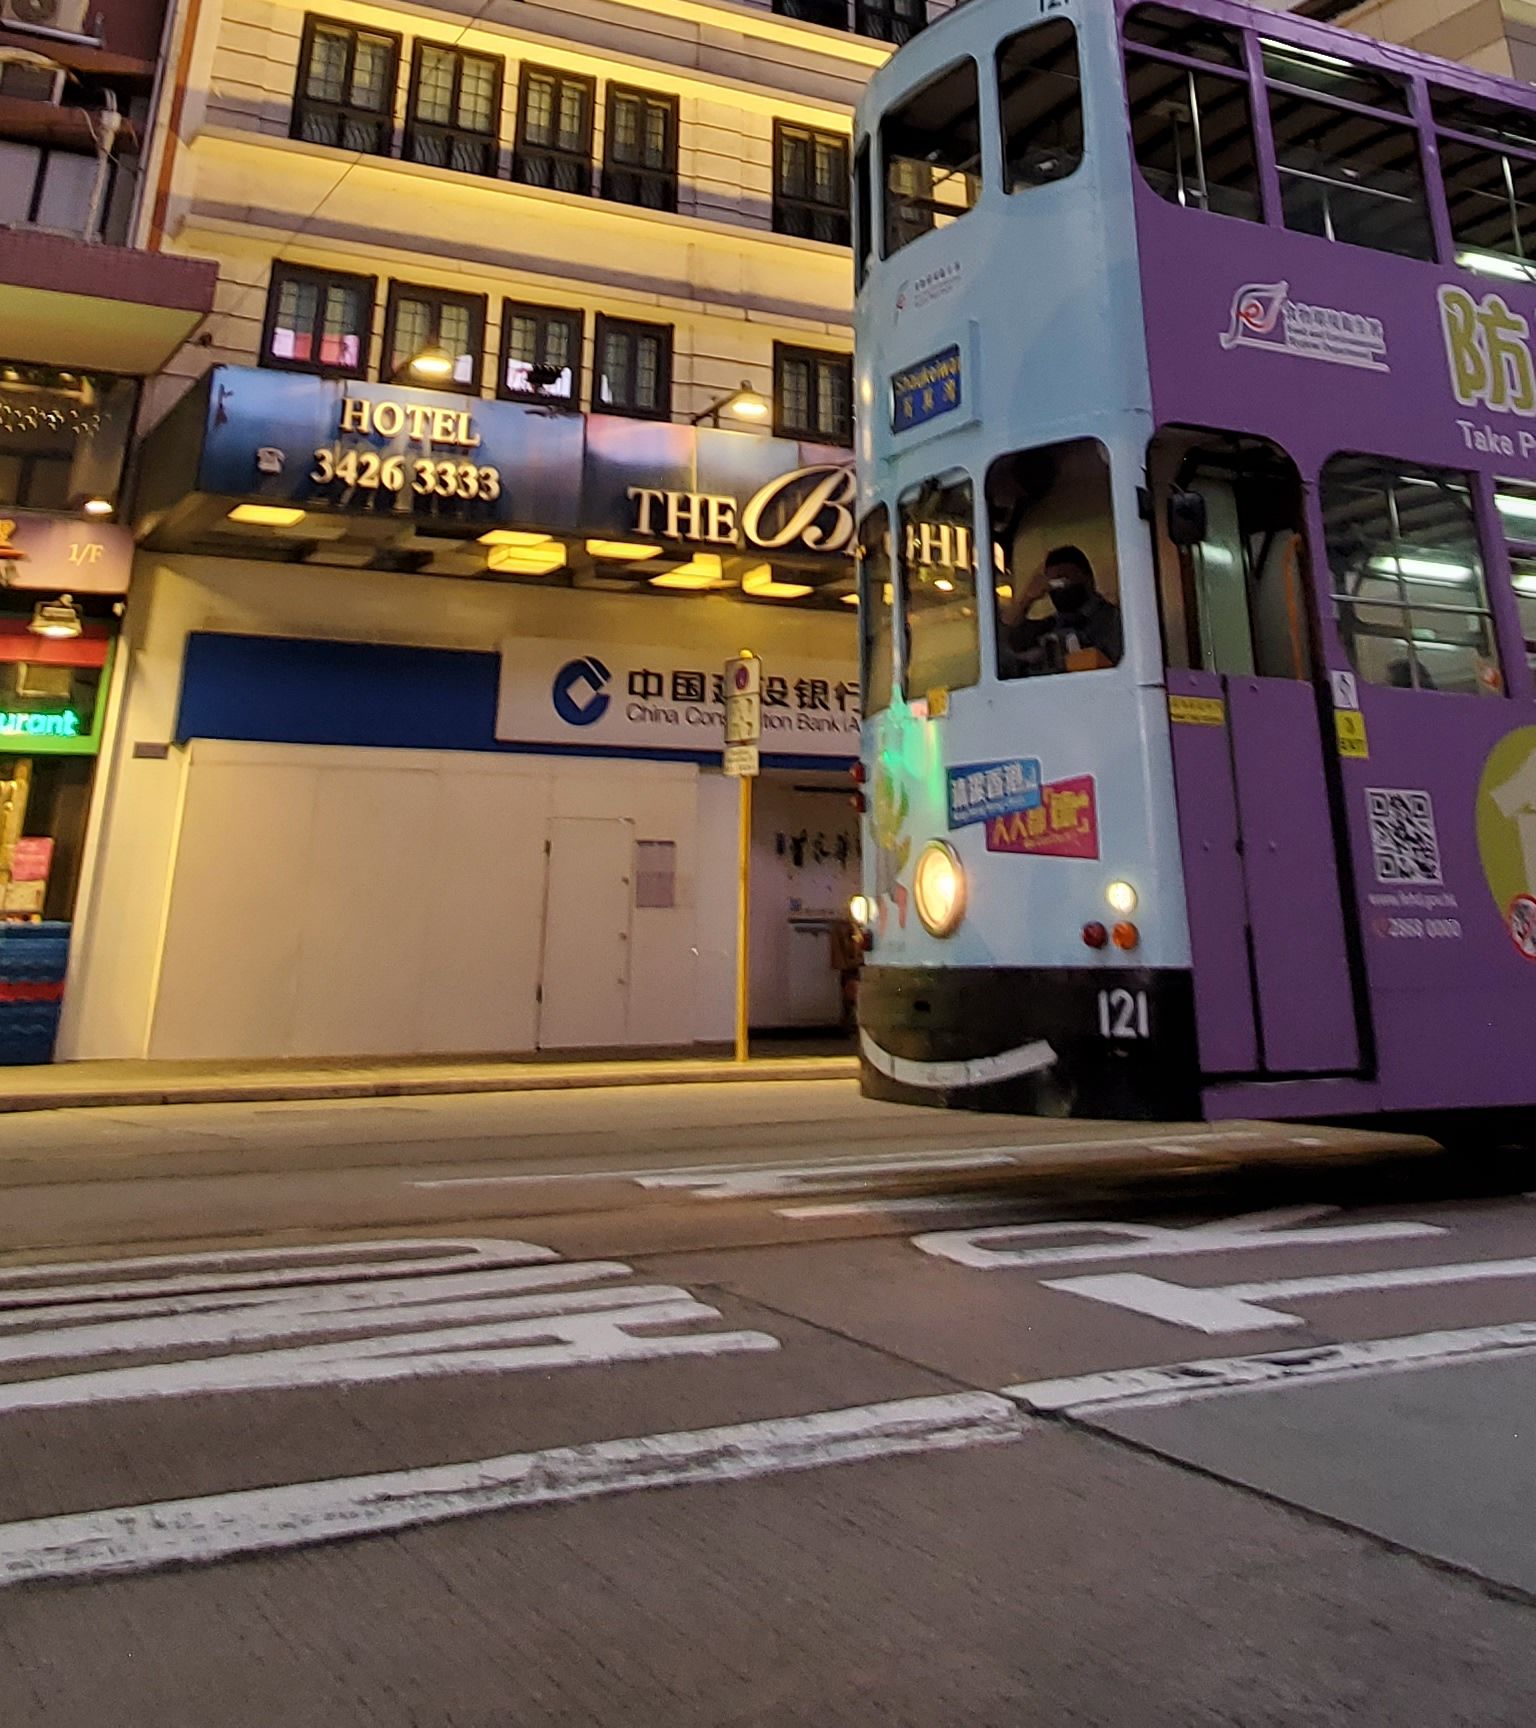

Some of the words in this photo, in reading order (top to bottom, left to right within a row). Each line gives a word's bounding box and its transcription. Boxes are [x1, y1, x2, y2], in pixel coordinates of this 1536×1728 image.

[337, 397, 481, 448] HOTEL
[1456, 419, 1514, 457] Take
[310, 439, 406, 492] 3426
[411, 457, 500, 502] 3333
[627, 485, 740, 545] THE
[67, 542, 105, 567] 1/F
[625, 702, 680, 725] China
[797, 712, 841, 733] Bank
[1098, 988, 1150, 1038] 121
